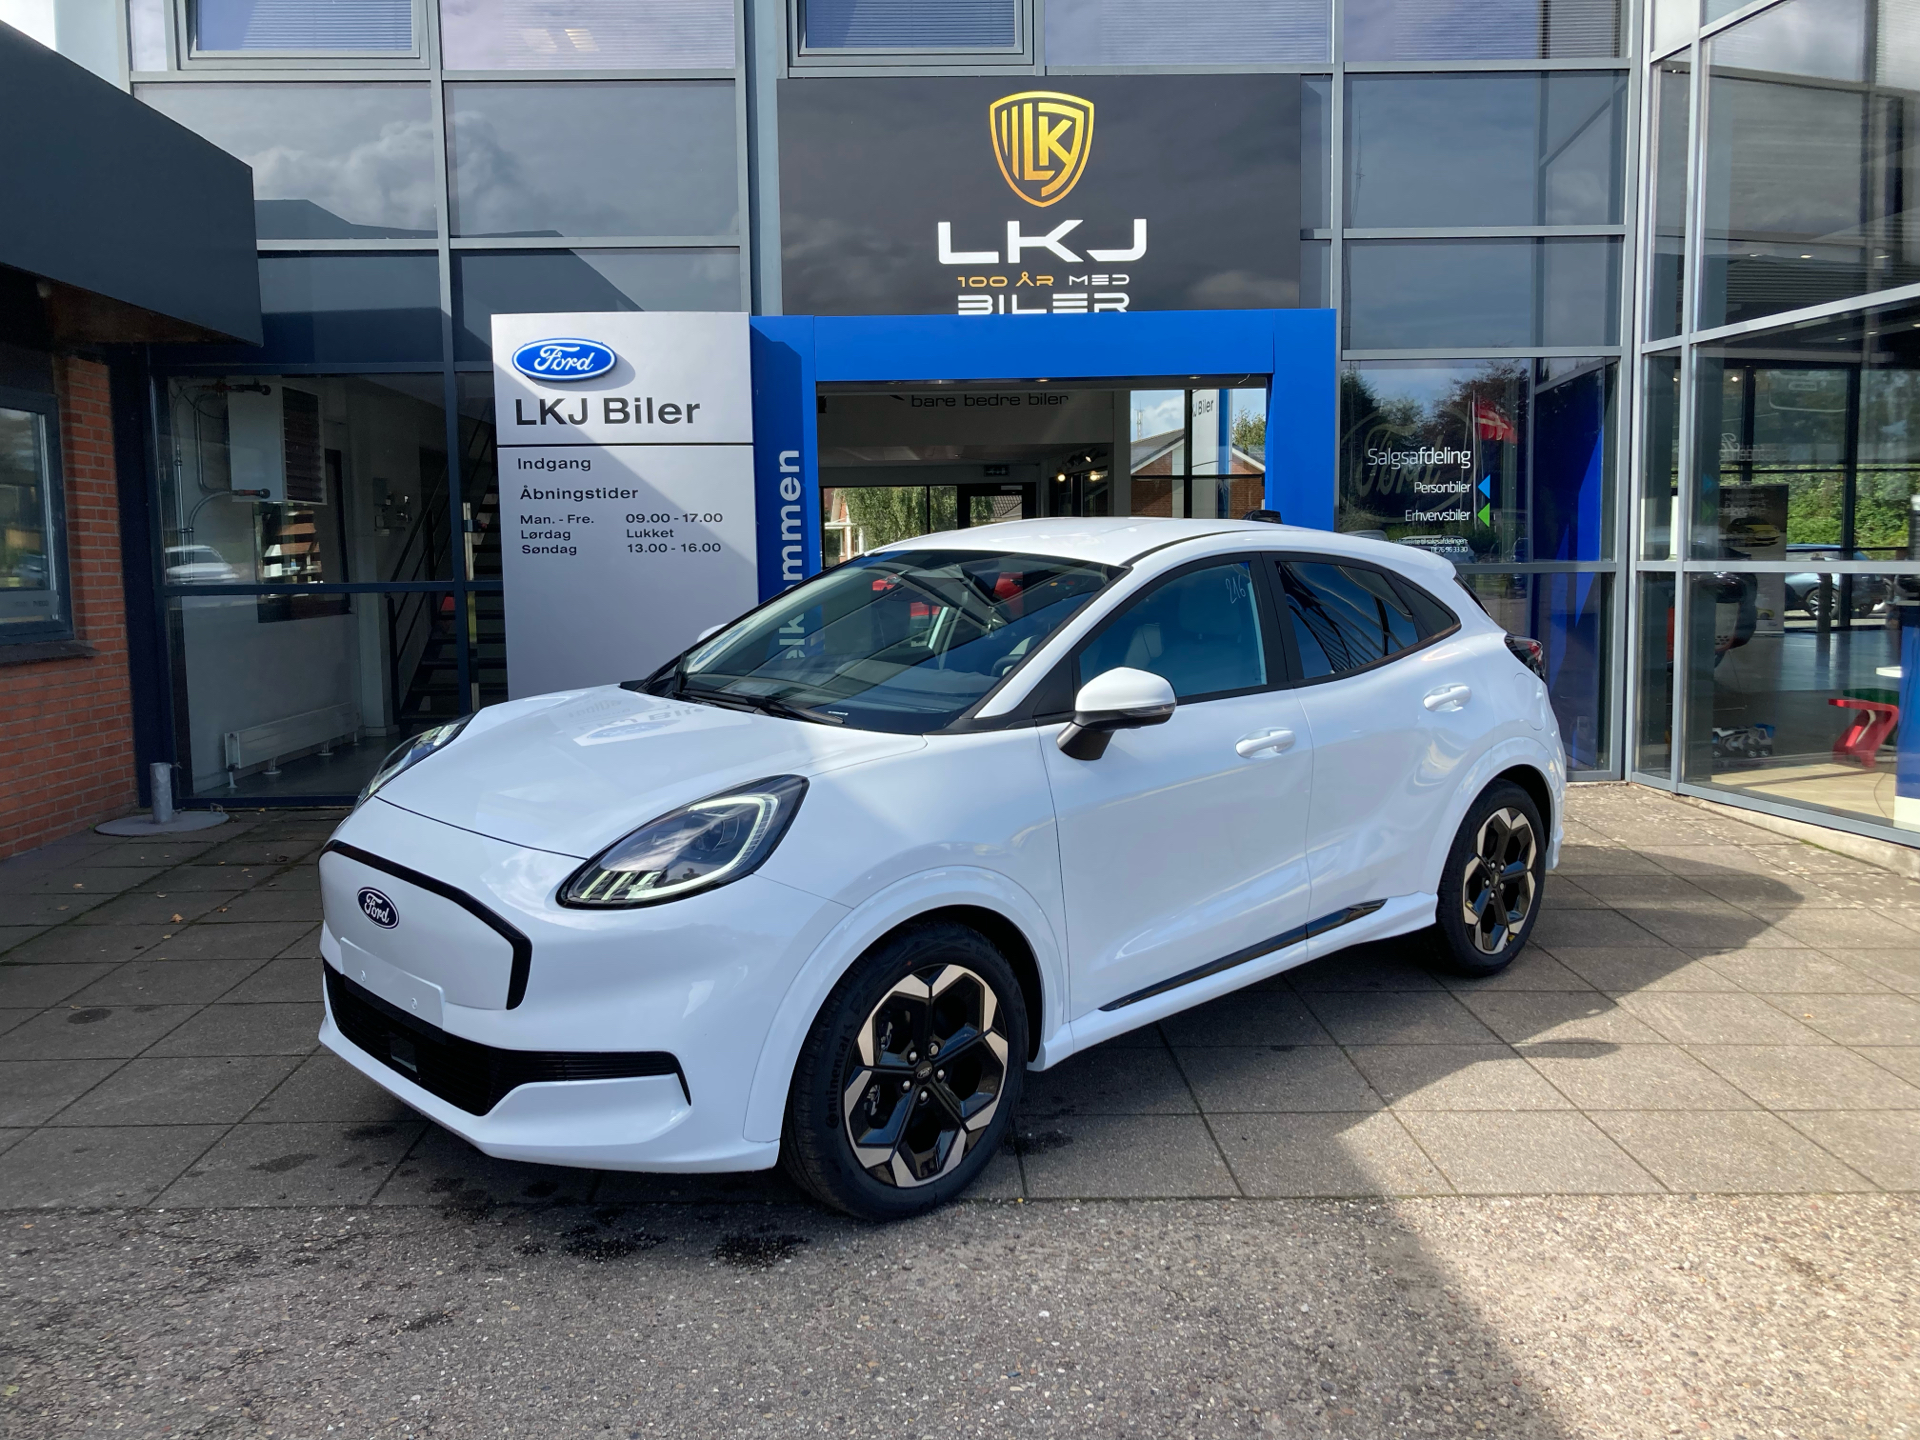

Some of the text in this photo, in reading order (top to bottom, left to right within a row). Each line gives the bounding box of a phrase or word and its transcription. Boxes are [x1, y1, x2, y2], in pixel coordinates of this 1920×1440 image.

[938, 218, 1147, 265] LKJ
[957, 271, 1130, 287] 100 ÅR MED
[958, 292, 1130, 315] BILER
[533, 345, 596, 371] Ford
[911, 392, 1069, 408] bare bedre biler
[515, 397, 701, 426] LKJ Biler
[517, 457, 591, 472] Indgang
[1367, 447, 1471, 470] Salgsafdeling
[520, 485, 639, 502] Åbningstider
[1414, 481, 1471, 494] Personbiler
[520, 514, 556, 525] Man.
[567, 514, 594, 524] Fre.
[625, 513, 671, 523] 09.00
[682, 513, 723, 523] 17.00
[1405, 509, 1470, 522] Erhvervsbiler
[521, 528, 674, 541] Lørdag Lukket
[521, 544, 577, 556] Søndag
[627, 543, 668, 553] 13.00
[680, 542, 721, 553] 16.00
[364, 892, 390, 924] Ford
